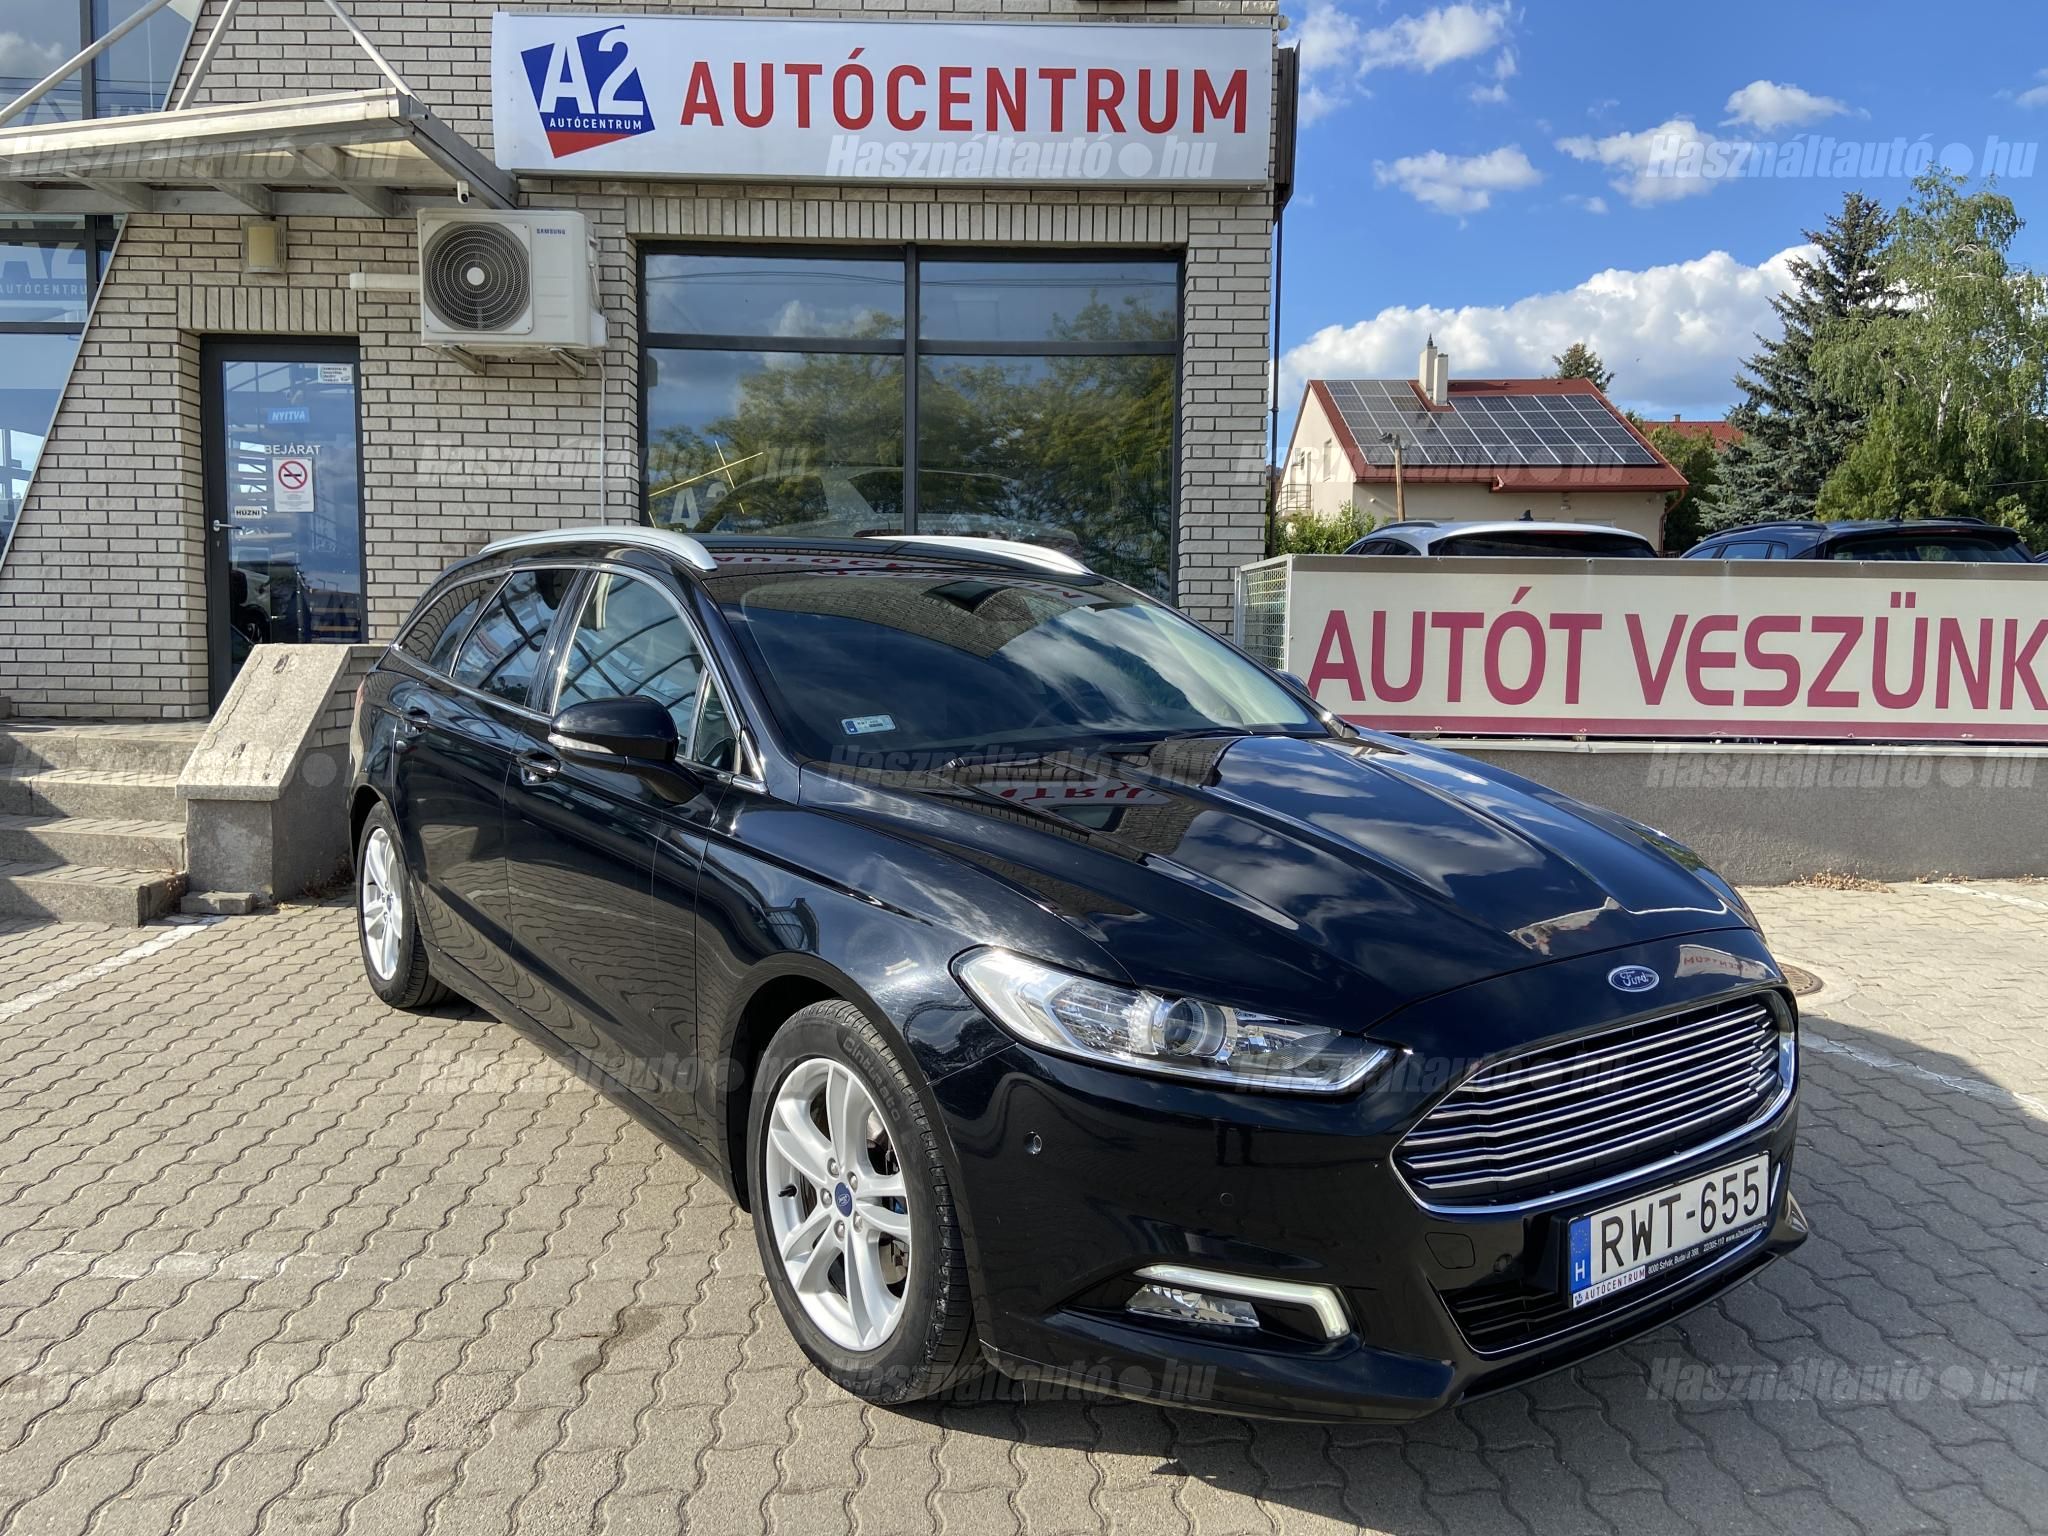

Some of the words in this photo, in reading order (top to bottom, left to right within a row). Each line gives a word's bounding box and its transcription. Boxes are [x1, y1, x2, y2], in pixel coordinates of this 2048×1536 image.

[540, 28, 643, 115] A2
[680, 47, 1248, 134] AUTÓCENTRUM
[549, 116, 642, 130] AUTÓCENTRUM
[272, 410, 305, 421] NYITVA
[264, 442, 320, 455] BEJÁRAT
[1308, 586, 1602, 706] AUTÓT
[1625, 592, 2048, 711] VESZÜNK
[1601, 1165, 1759, 1274] RWT-655
[1575, 1260, 1586, 1282] H
[1584, 1268, 1646, 1300] AUTÓCENTRUM
